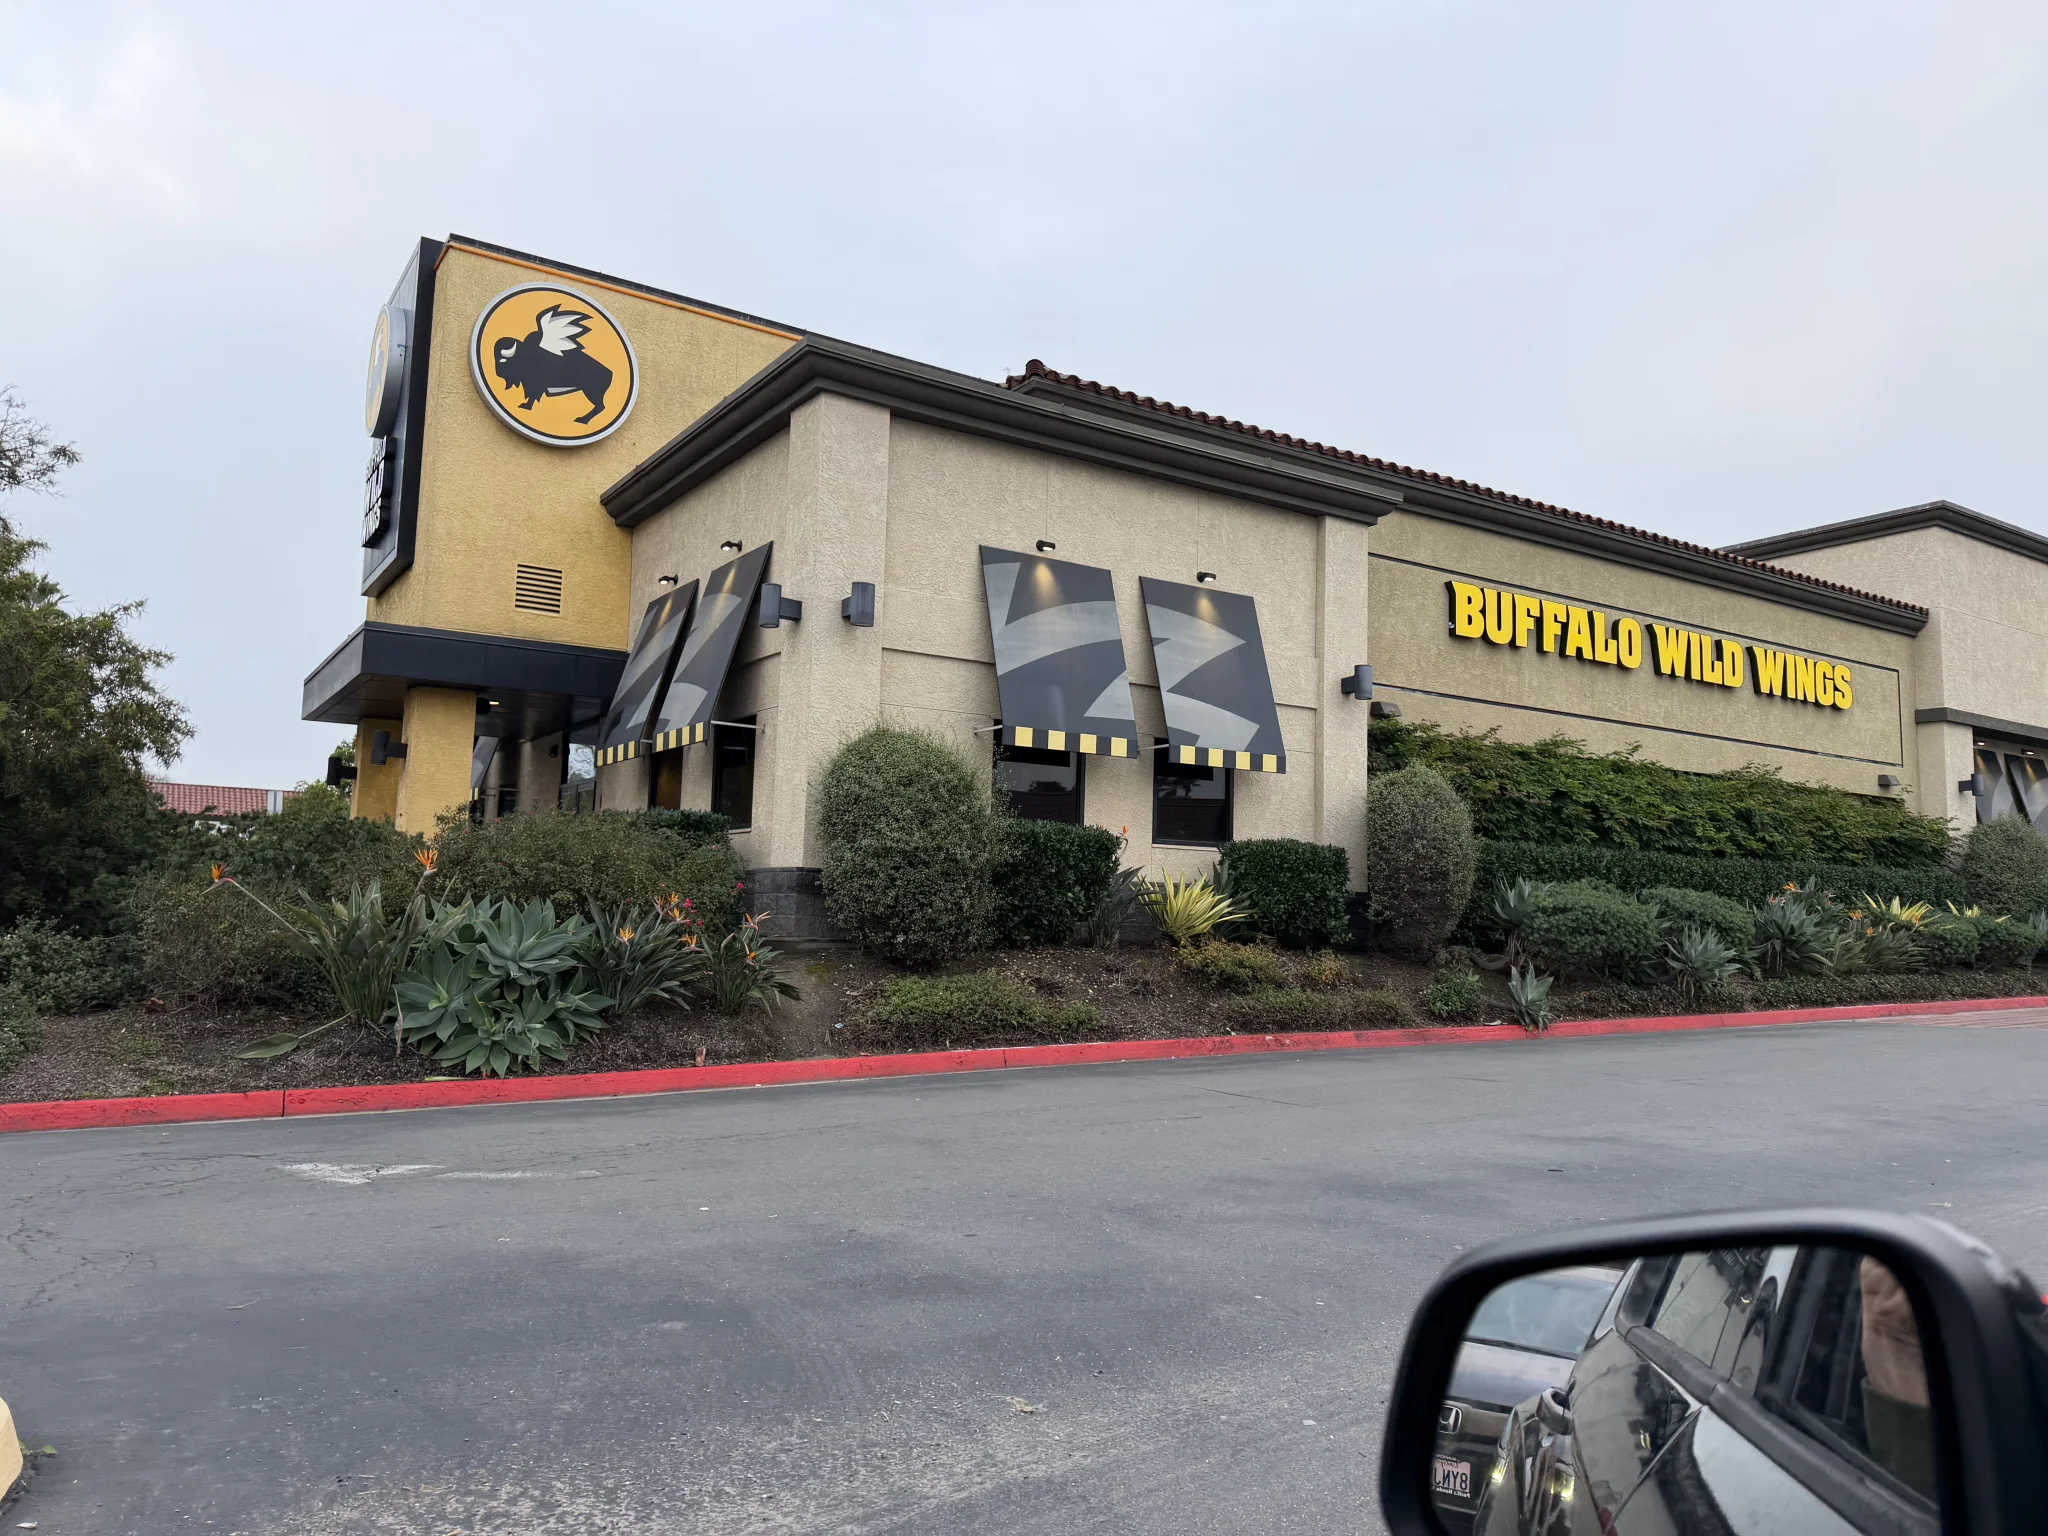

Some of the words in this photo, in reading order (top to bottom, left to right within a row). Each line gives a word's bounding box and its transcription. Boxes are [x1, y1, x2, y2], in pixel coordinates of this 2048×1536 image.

[1450, 581, 1642, 669] BUFFALO
[1650, 623, 1745, 688] WILD
[1751, 647, 1853, 709] WINGS
